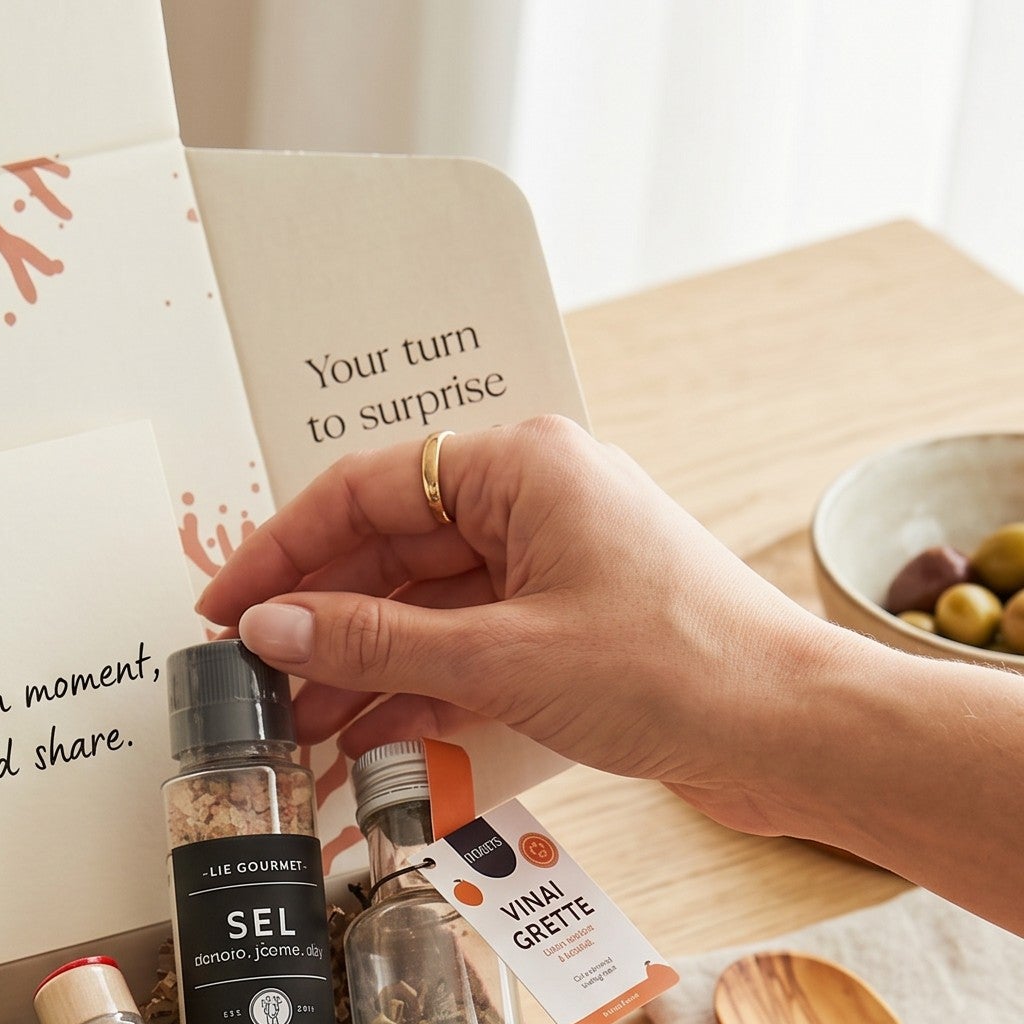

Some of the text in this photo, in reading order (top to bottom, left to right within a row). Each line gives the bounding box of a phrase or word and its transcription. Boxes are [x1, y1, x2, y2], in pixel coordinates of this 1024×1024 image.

[304, 325, 480, 389] Your turn
[307, 371, 507, 443] to surprise
[24, 641, 162, 709] moment,
[34, 725, 135, 771] share.
[227, 907, 296, 940] SEL
[499, 880, 565, 922] VINAI
[513, 896, 596, 950] GRETTE
